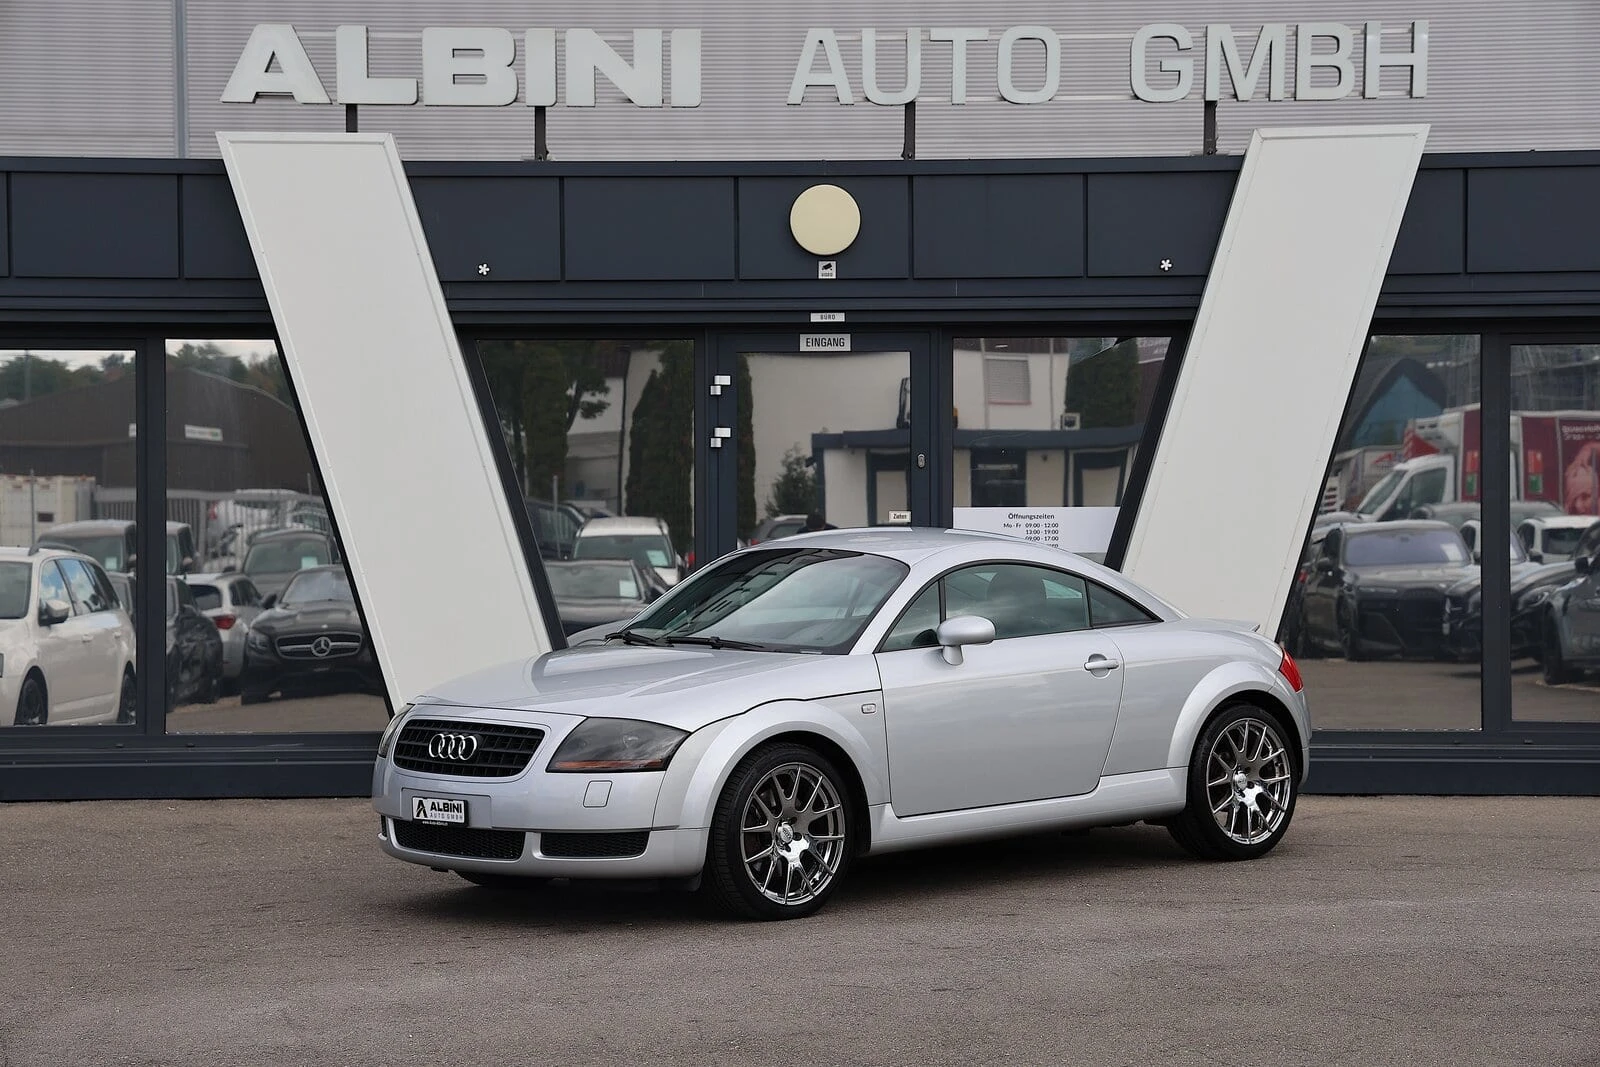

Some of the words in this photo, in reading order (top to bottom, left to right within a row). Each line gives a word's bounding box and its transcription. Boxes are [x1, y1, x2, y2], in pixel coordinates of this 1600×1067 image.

[220, 24, 702, 107] ALBINI
[787, 25, 1061, 106] AUTO
[1129, 20, 1429, 102] GMBH
[806, 337, 845, 347] EINGANG
[1008, 512, 1055, 520] Öffnungszeiten
[430, 801, 462, 814] ALBINI
